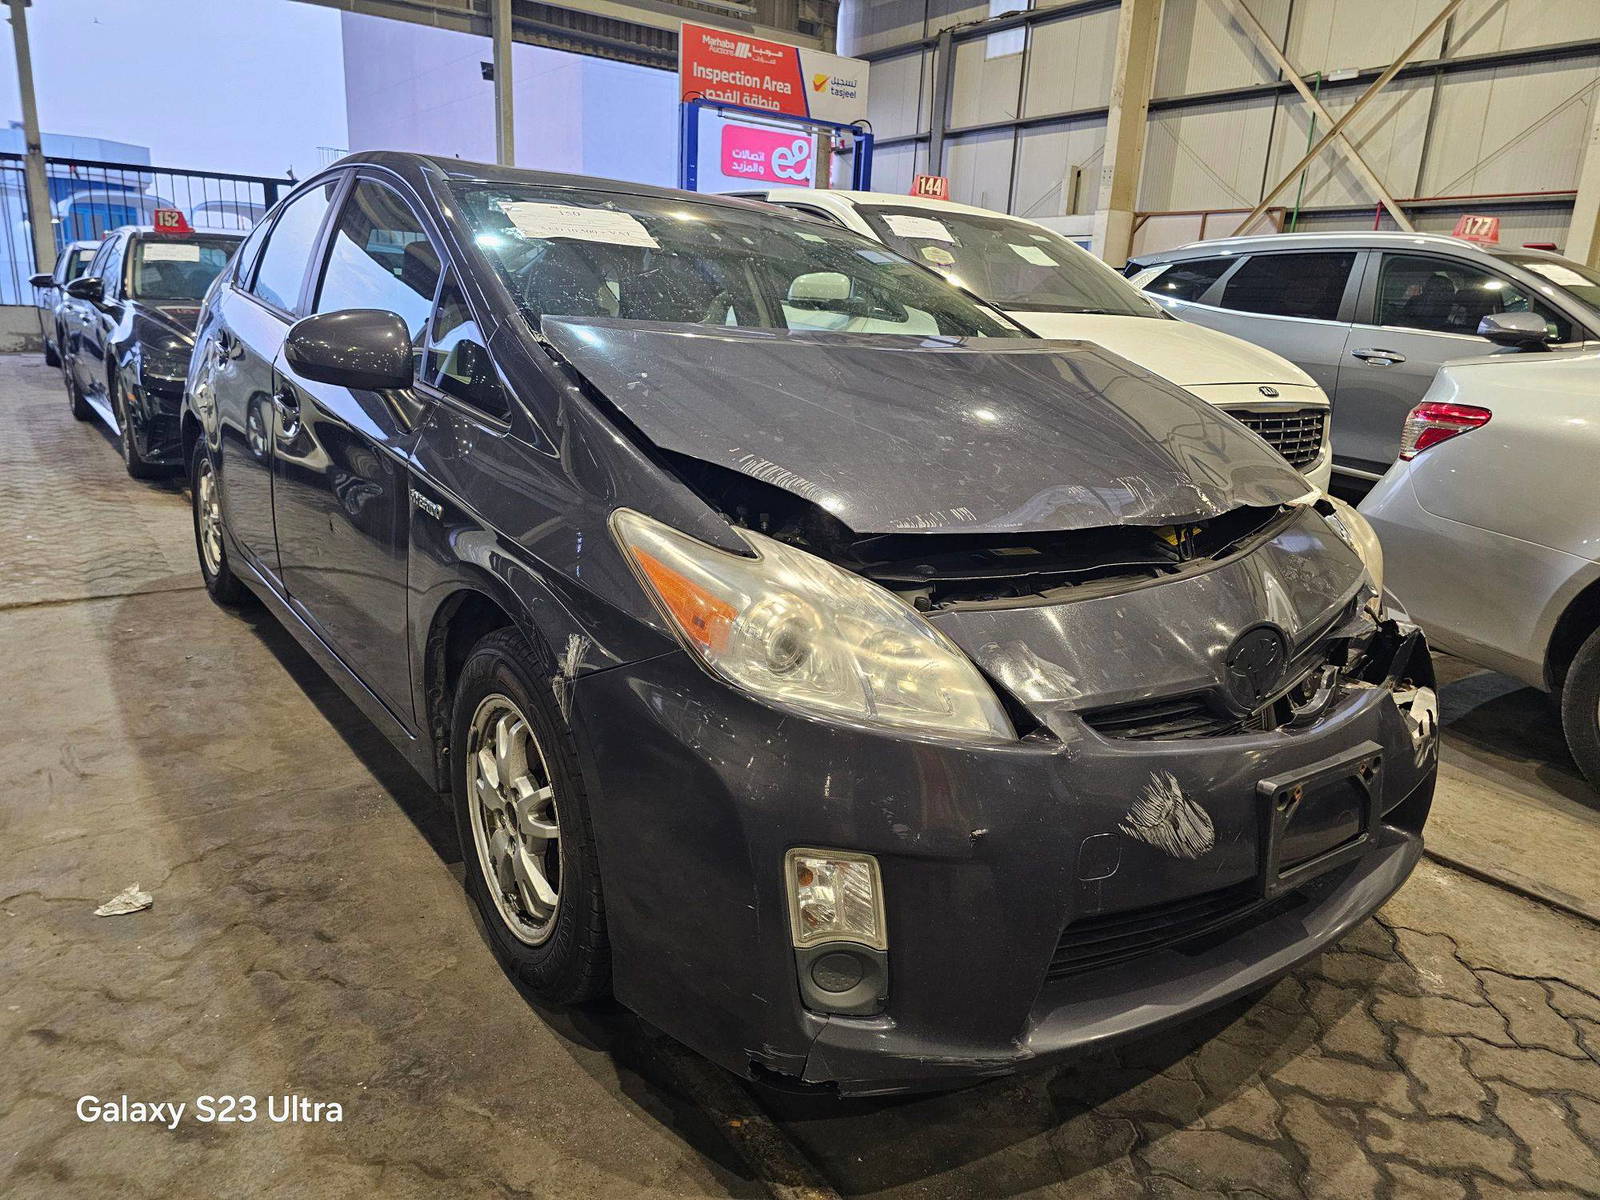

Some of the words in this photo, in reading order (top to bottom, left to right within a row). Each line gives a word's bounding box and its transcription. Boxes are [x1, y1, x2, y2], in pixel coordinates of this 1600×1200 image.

[702, 35, 735, 50] Marhaba
[693, 62, 760, 89] Inspection
[763, 76, 792, 95] Area
[831, 87, 857, 99] tasjeel
[742, 92, 780, 111] منطقة
[920, 177, 941, 195] 144
[158, 211, 179, 226] 152
[1465, 218, 1493, 234] 177
